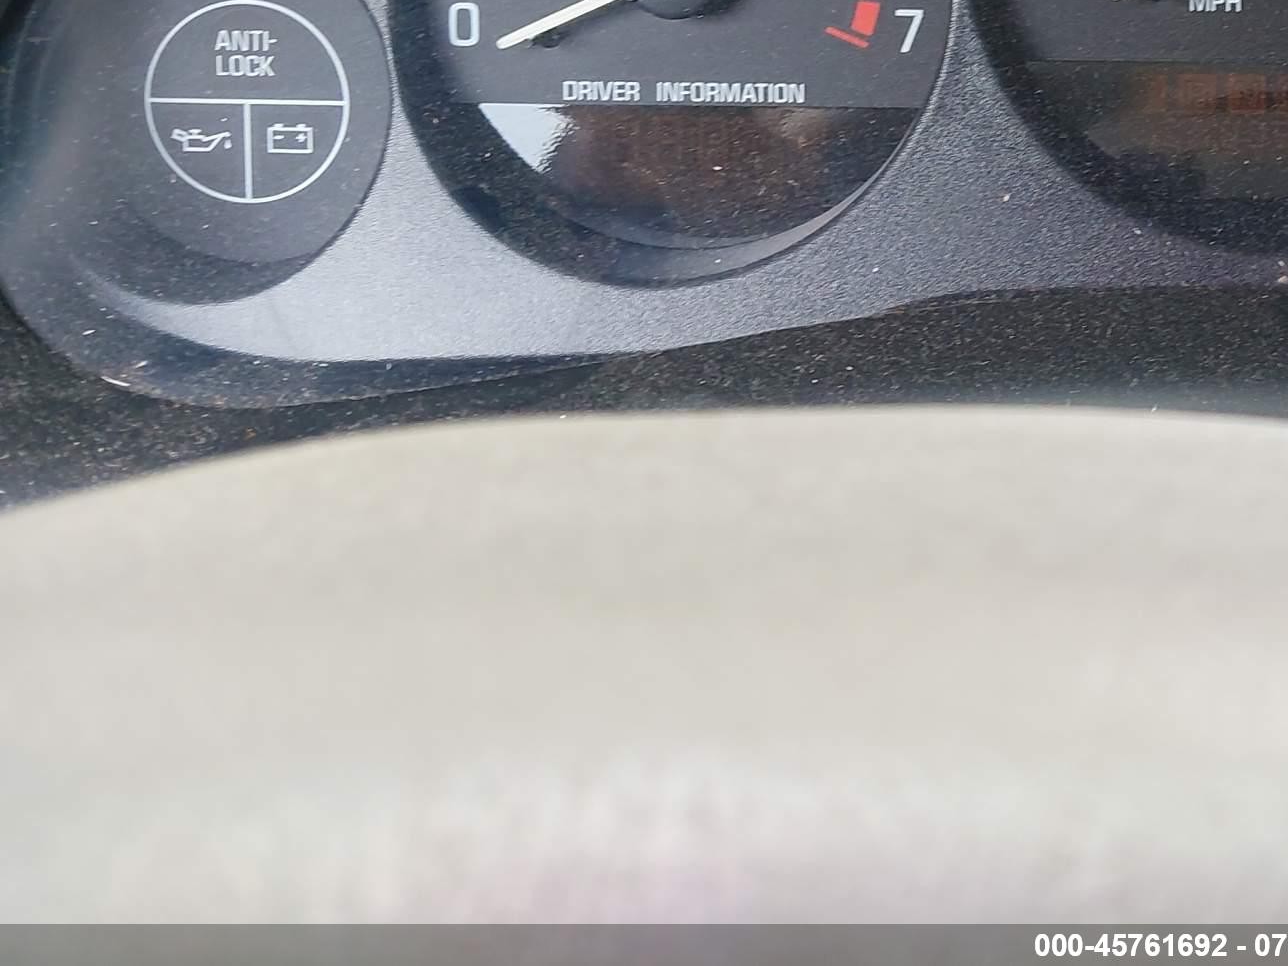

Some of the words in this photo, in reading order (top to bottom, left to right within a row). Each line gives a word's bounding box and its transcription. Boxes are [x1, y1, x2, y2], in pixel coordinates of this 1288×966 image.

[448, 3, 479, 47] 0
[894, 10, 924, 53] 7
[215, 30, 278, 51] ANTI-
[215, 55, 275, 77] LOCK
[562, 81, 640, 102] DRIVER
[656, 82, 805, 103] INFORMATION
